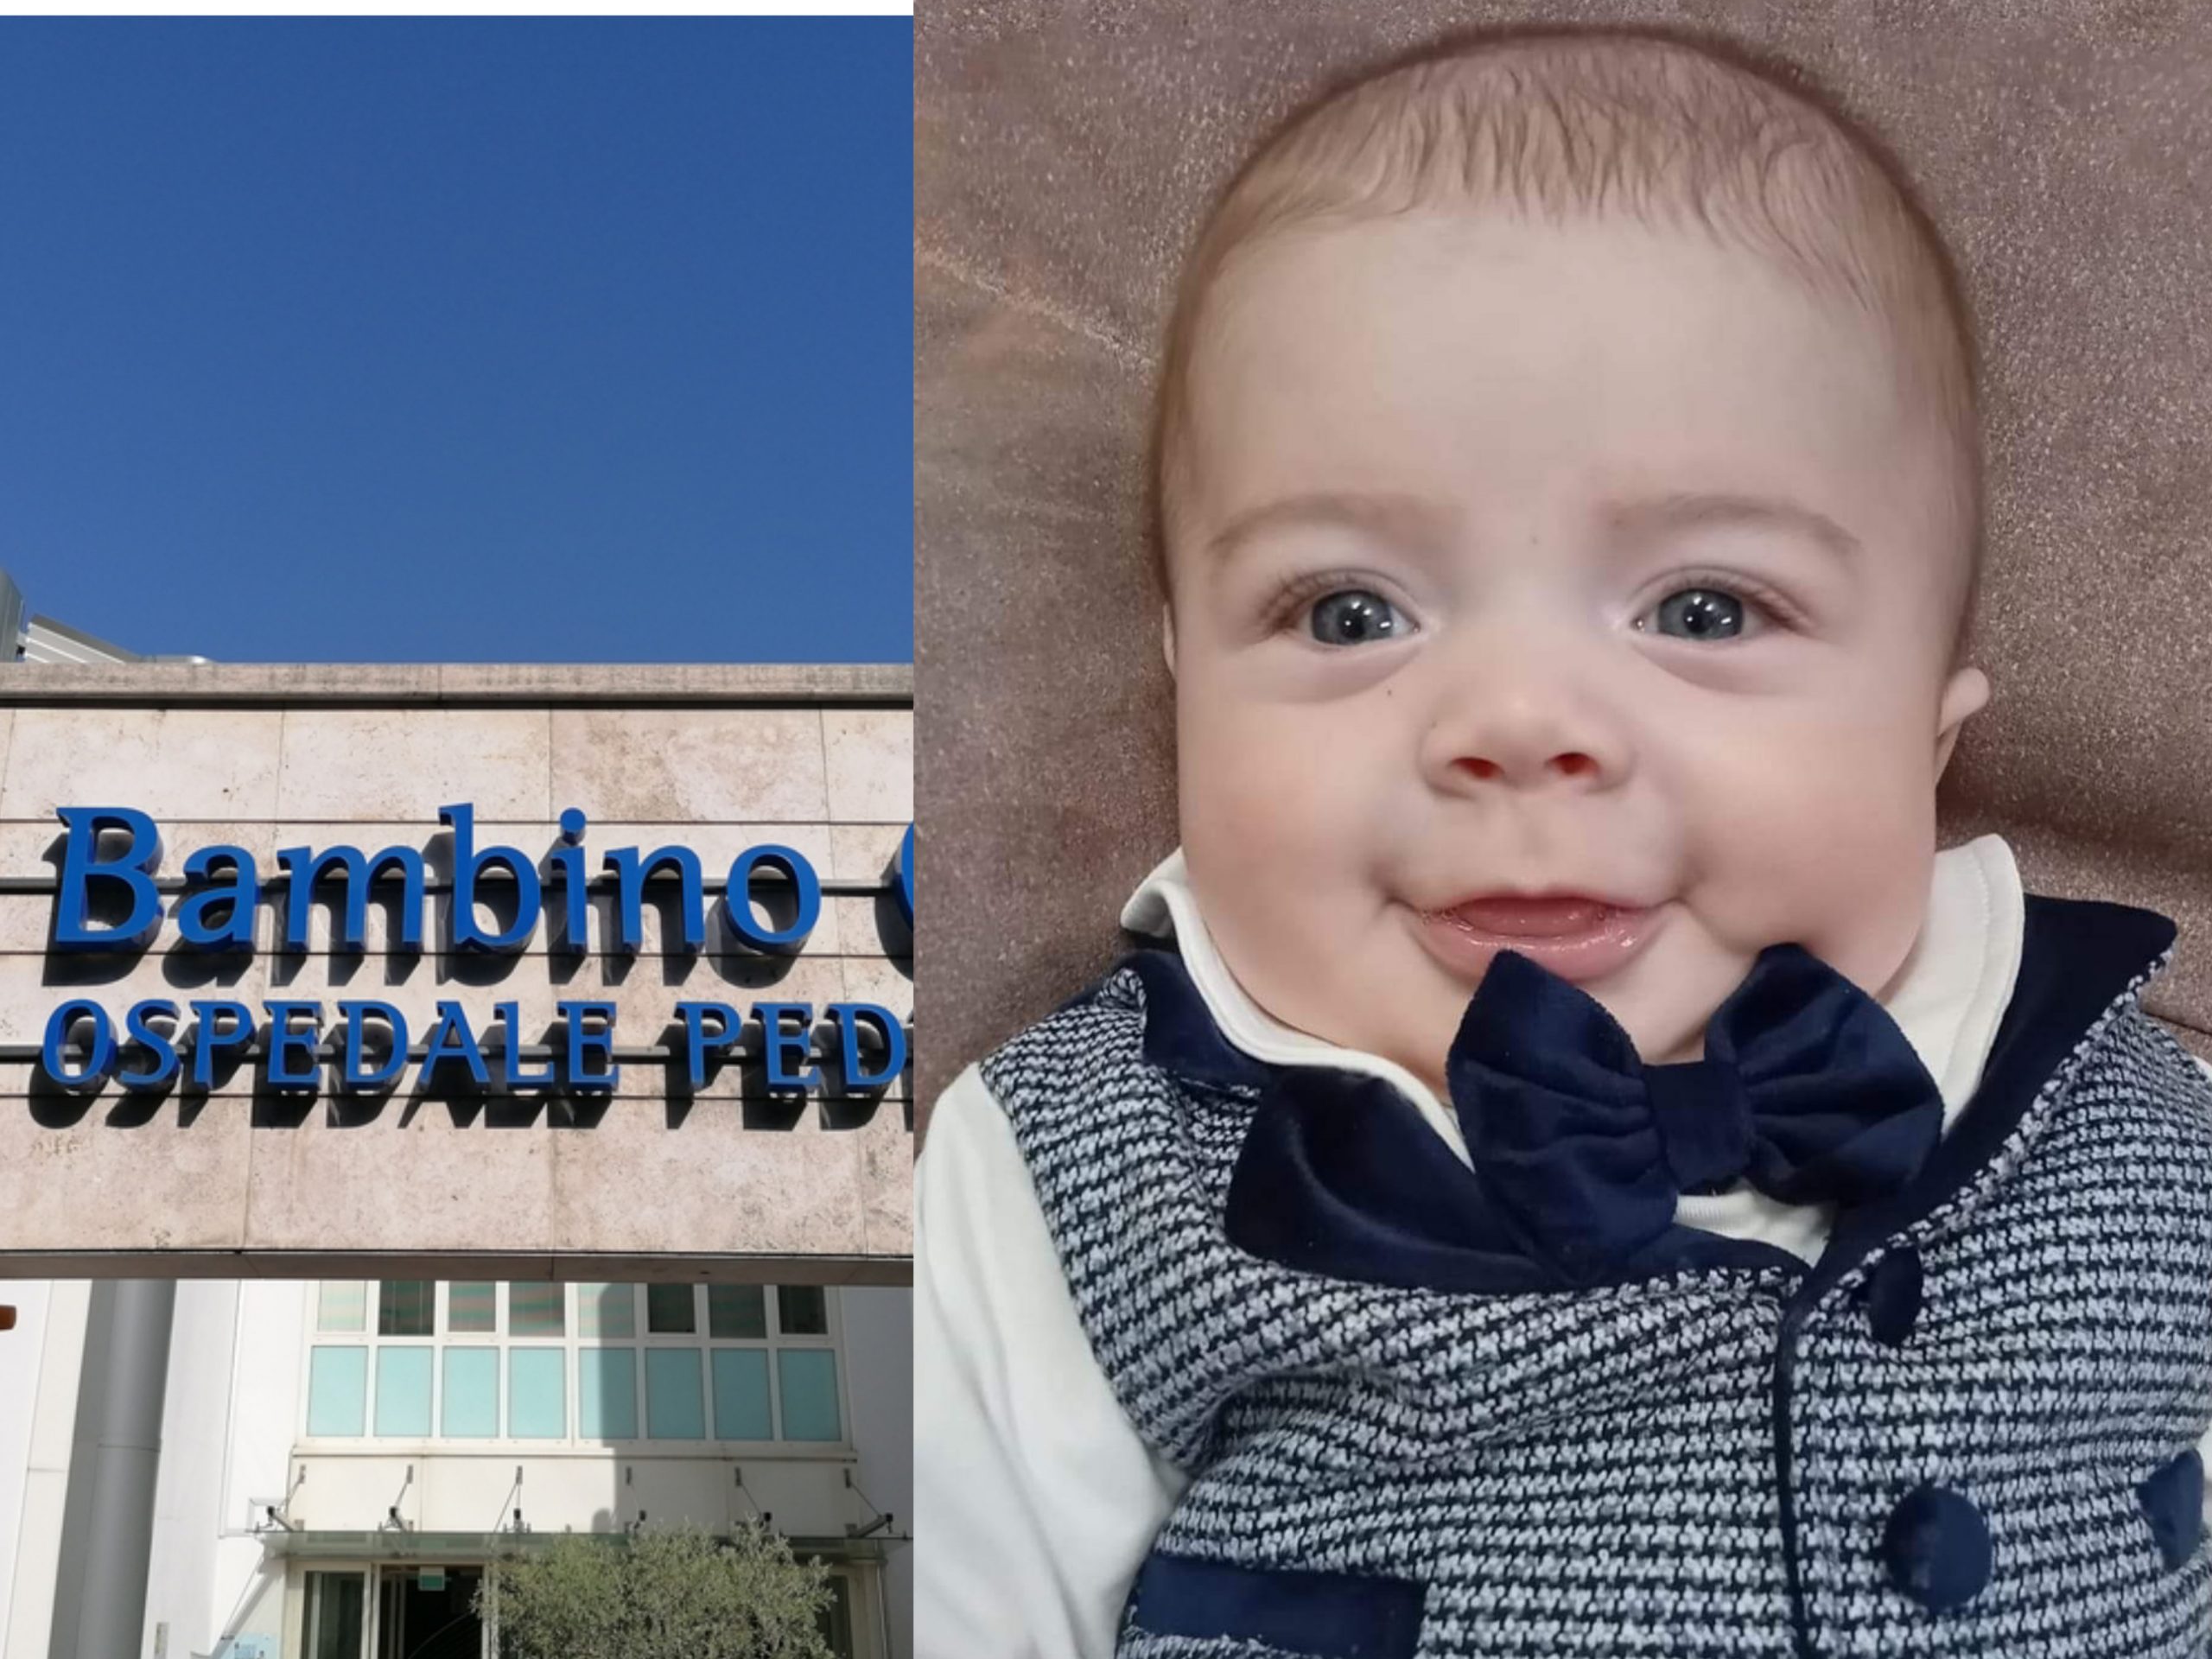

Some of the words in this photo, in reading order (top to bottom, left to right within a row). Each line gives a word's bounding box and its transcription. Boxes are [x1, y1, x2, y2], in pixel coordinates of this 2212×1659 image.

[55, 802, 822, 949] Bambino
[41, 998, 620, 1090] OSPEDALE
[674, 1001, 907, 1090] PED
